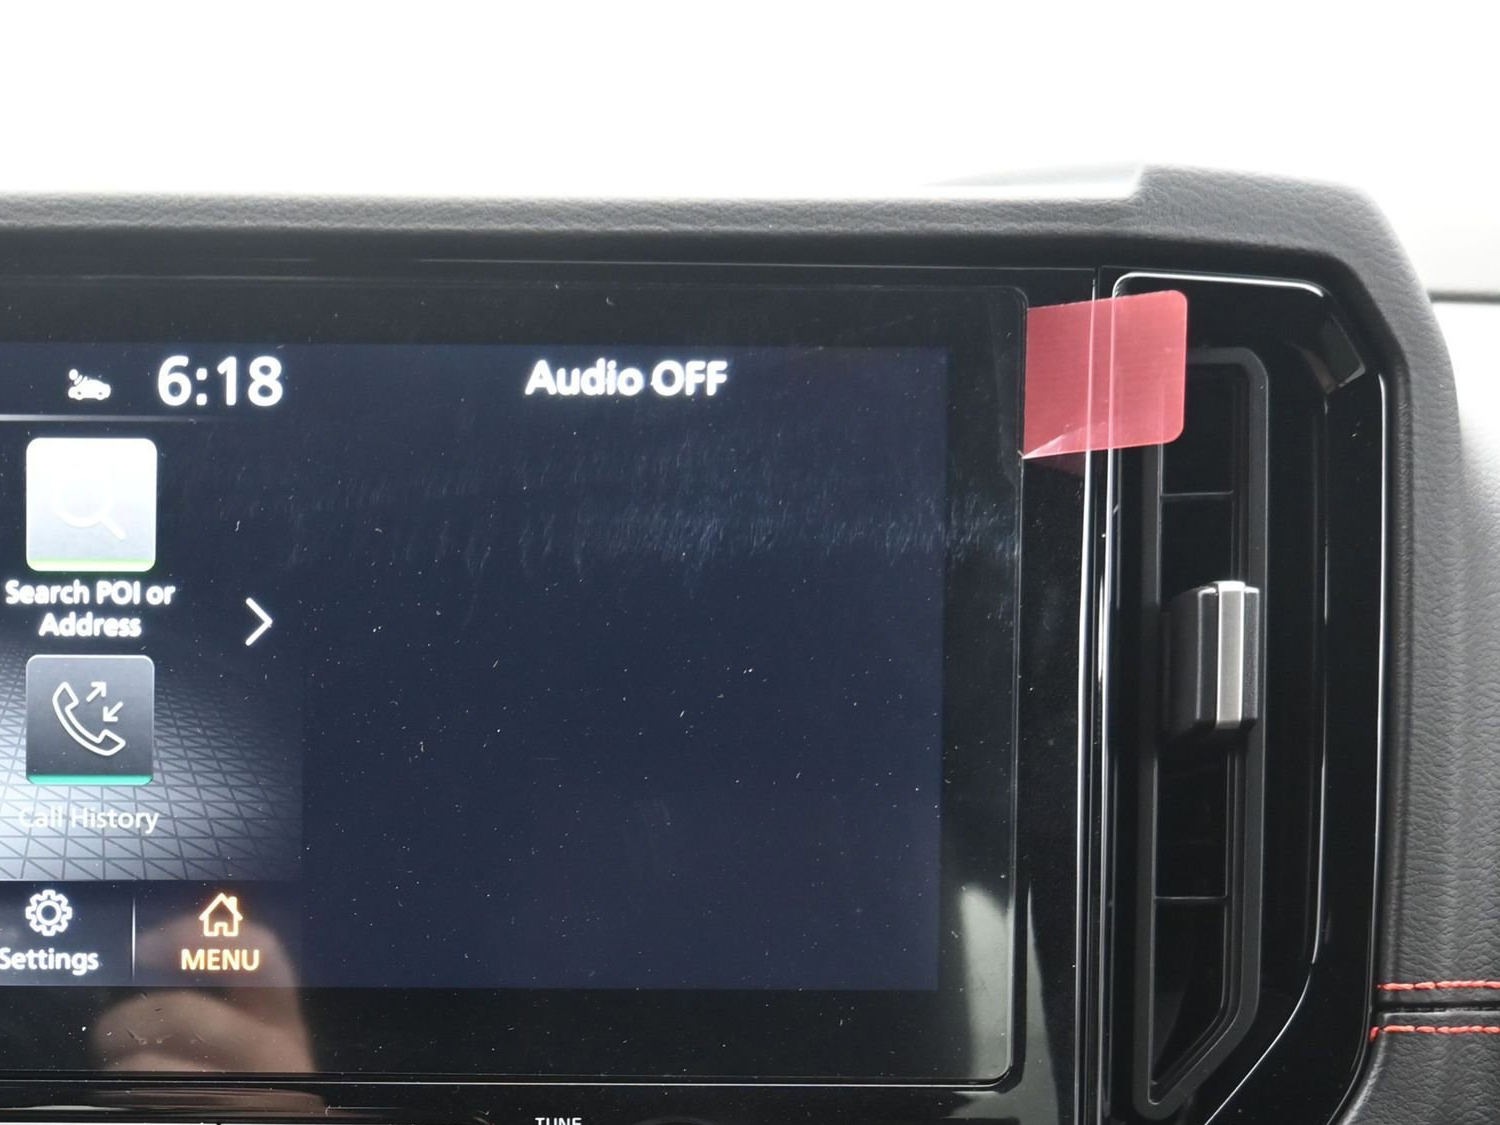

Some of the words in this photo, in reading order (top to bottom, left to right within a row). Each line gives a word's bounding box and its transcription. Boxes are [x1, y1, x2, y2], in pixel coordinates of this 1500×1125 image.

[157, 355, 283, 407] 6:18
[525, 359, 645, 396] Audio
[652, 360, 728, 397] OFF
[5, 580, 90, 605] Search
[96, 581, 141, 605] POI
[146, 586, 176, 605] or
[39, 613, 142, 637] Address
[18, 806, 63, 829] Call
[70, 808, 160, 834] History
[180, 949, 260, 971] MENU
